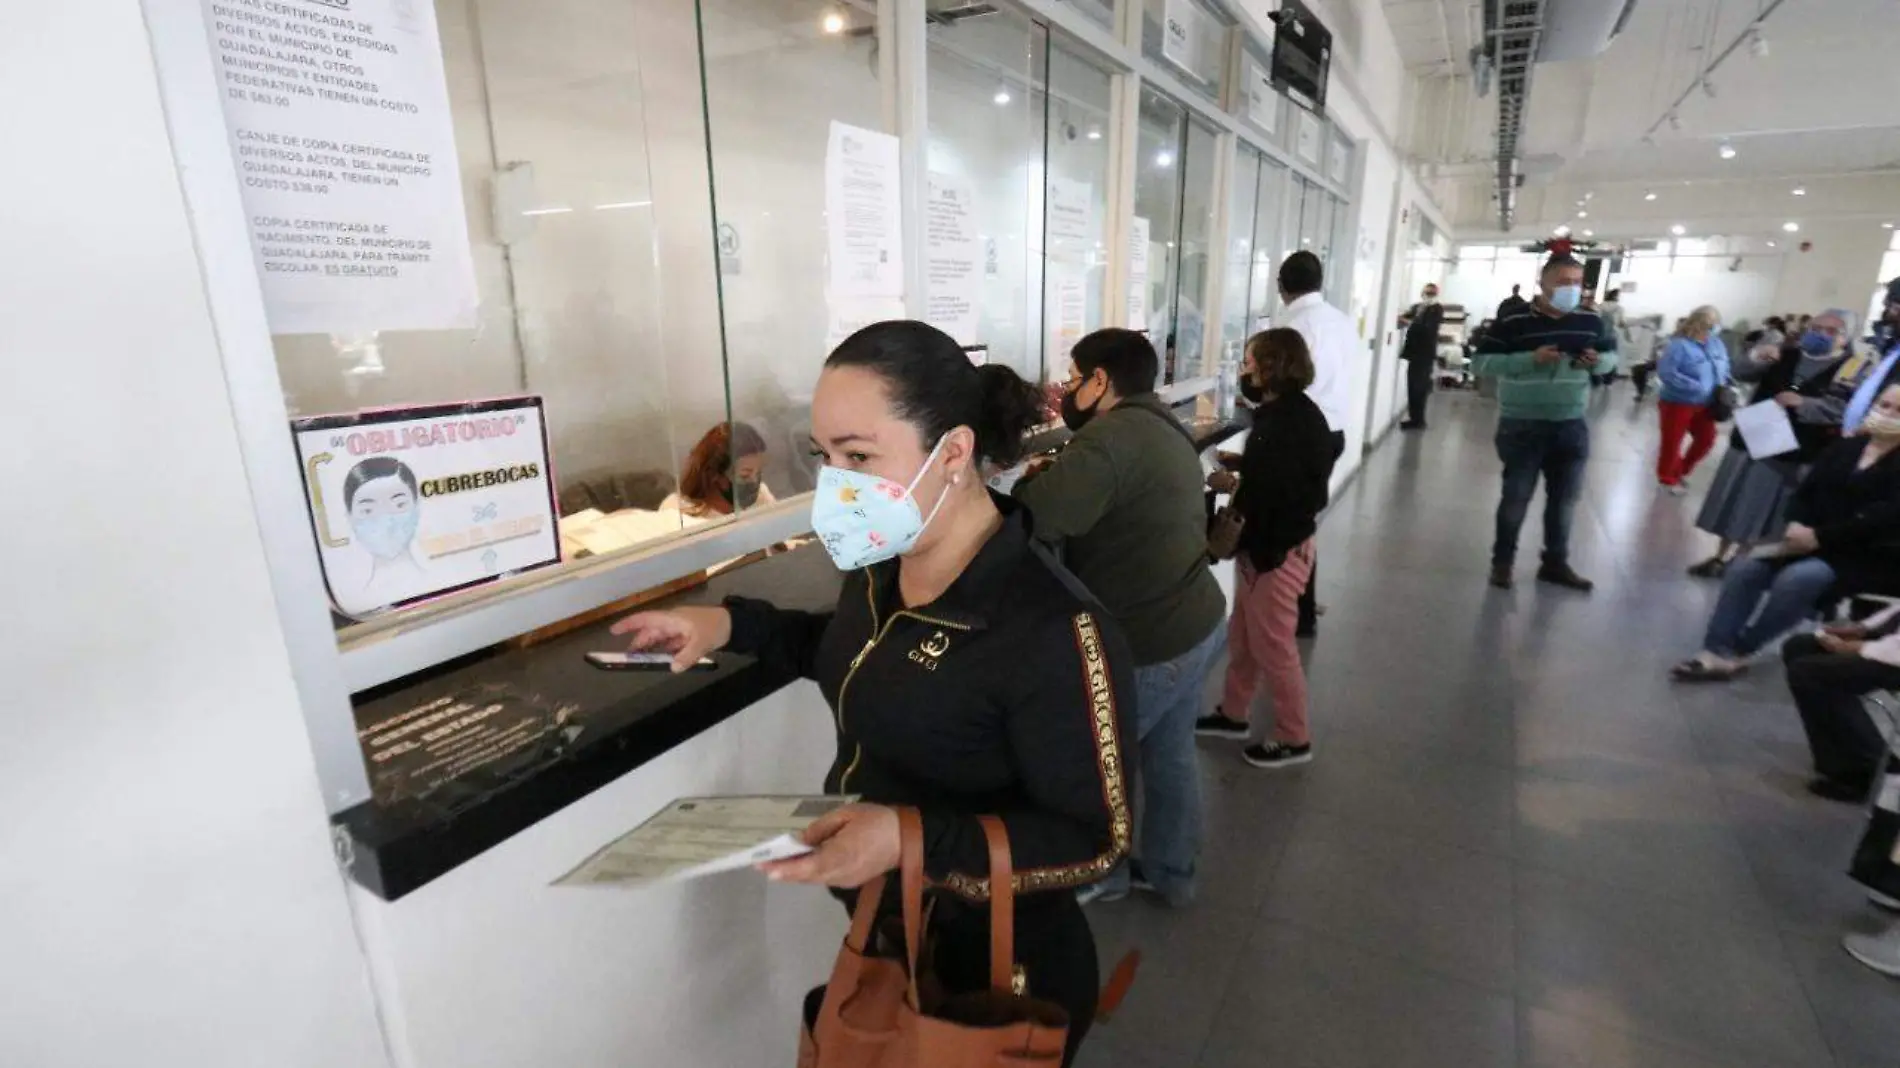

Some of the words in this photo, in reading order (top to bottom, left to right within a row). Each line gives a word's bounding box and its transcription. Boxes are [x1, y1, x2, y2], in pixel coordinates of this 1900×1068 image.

[336, 47, 352, 59] DE
[282, 134, 299, 147] DE
[302, 137, 338, 152] COPIA
[416, 152, 431, 164] DE
[353, 158, 374, 171] DEL
[253, 215, 290, 228] COPIA
[294, 219, 370, 234] CERTIFICADA
[373, 224, 388, 234] DE
[336, 236, 358, 247] DEL
[343, 265, 398, 277] GRATUITO
[420, 463, 539, 498] CUBREBOCAS
